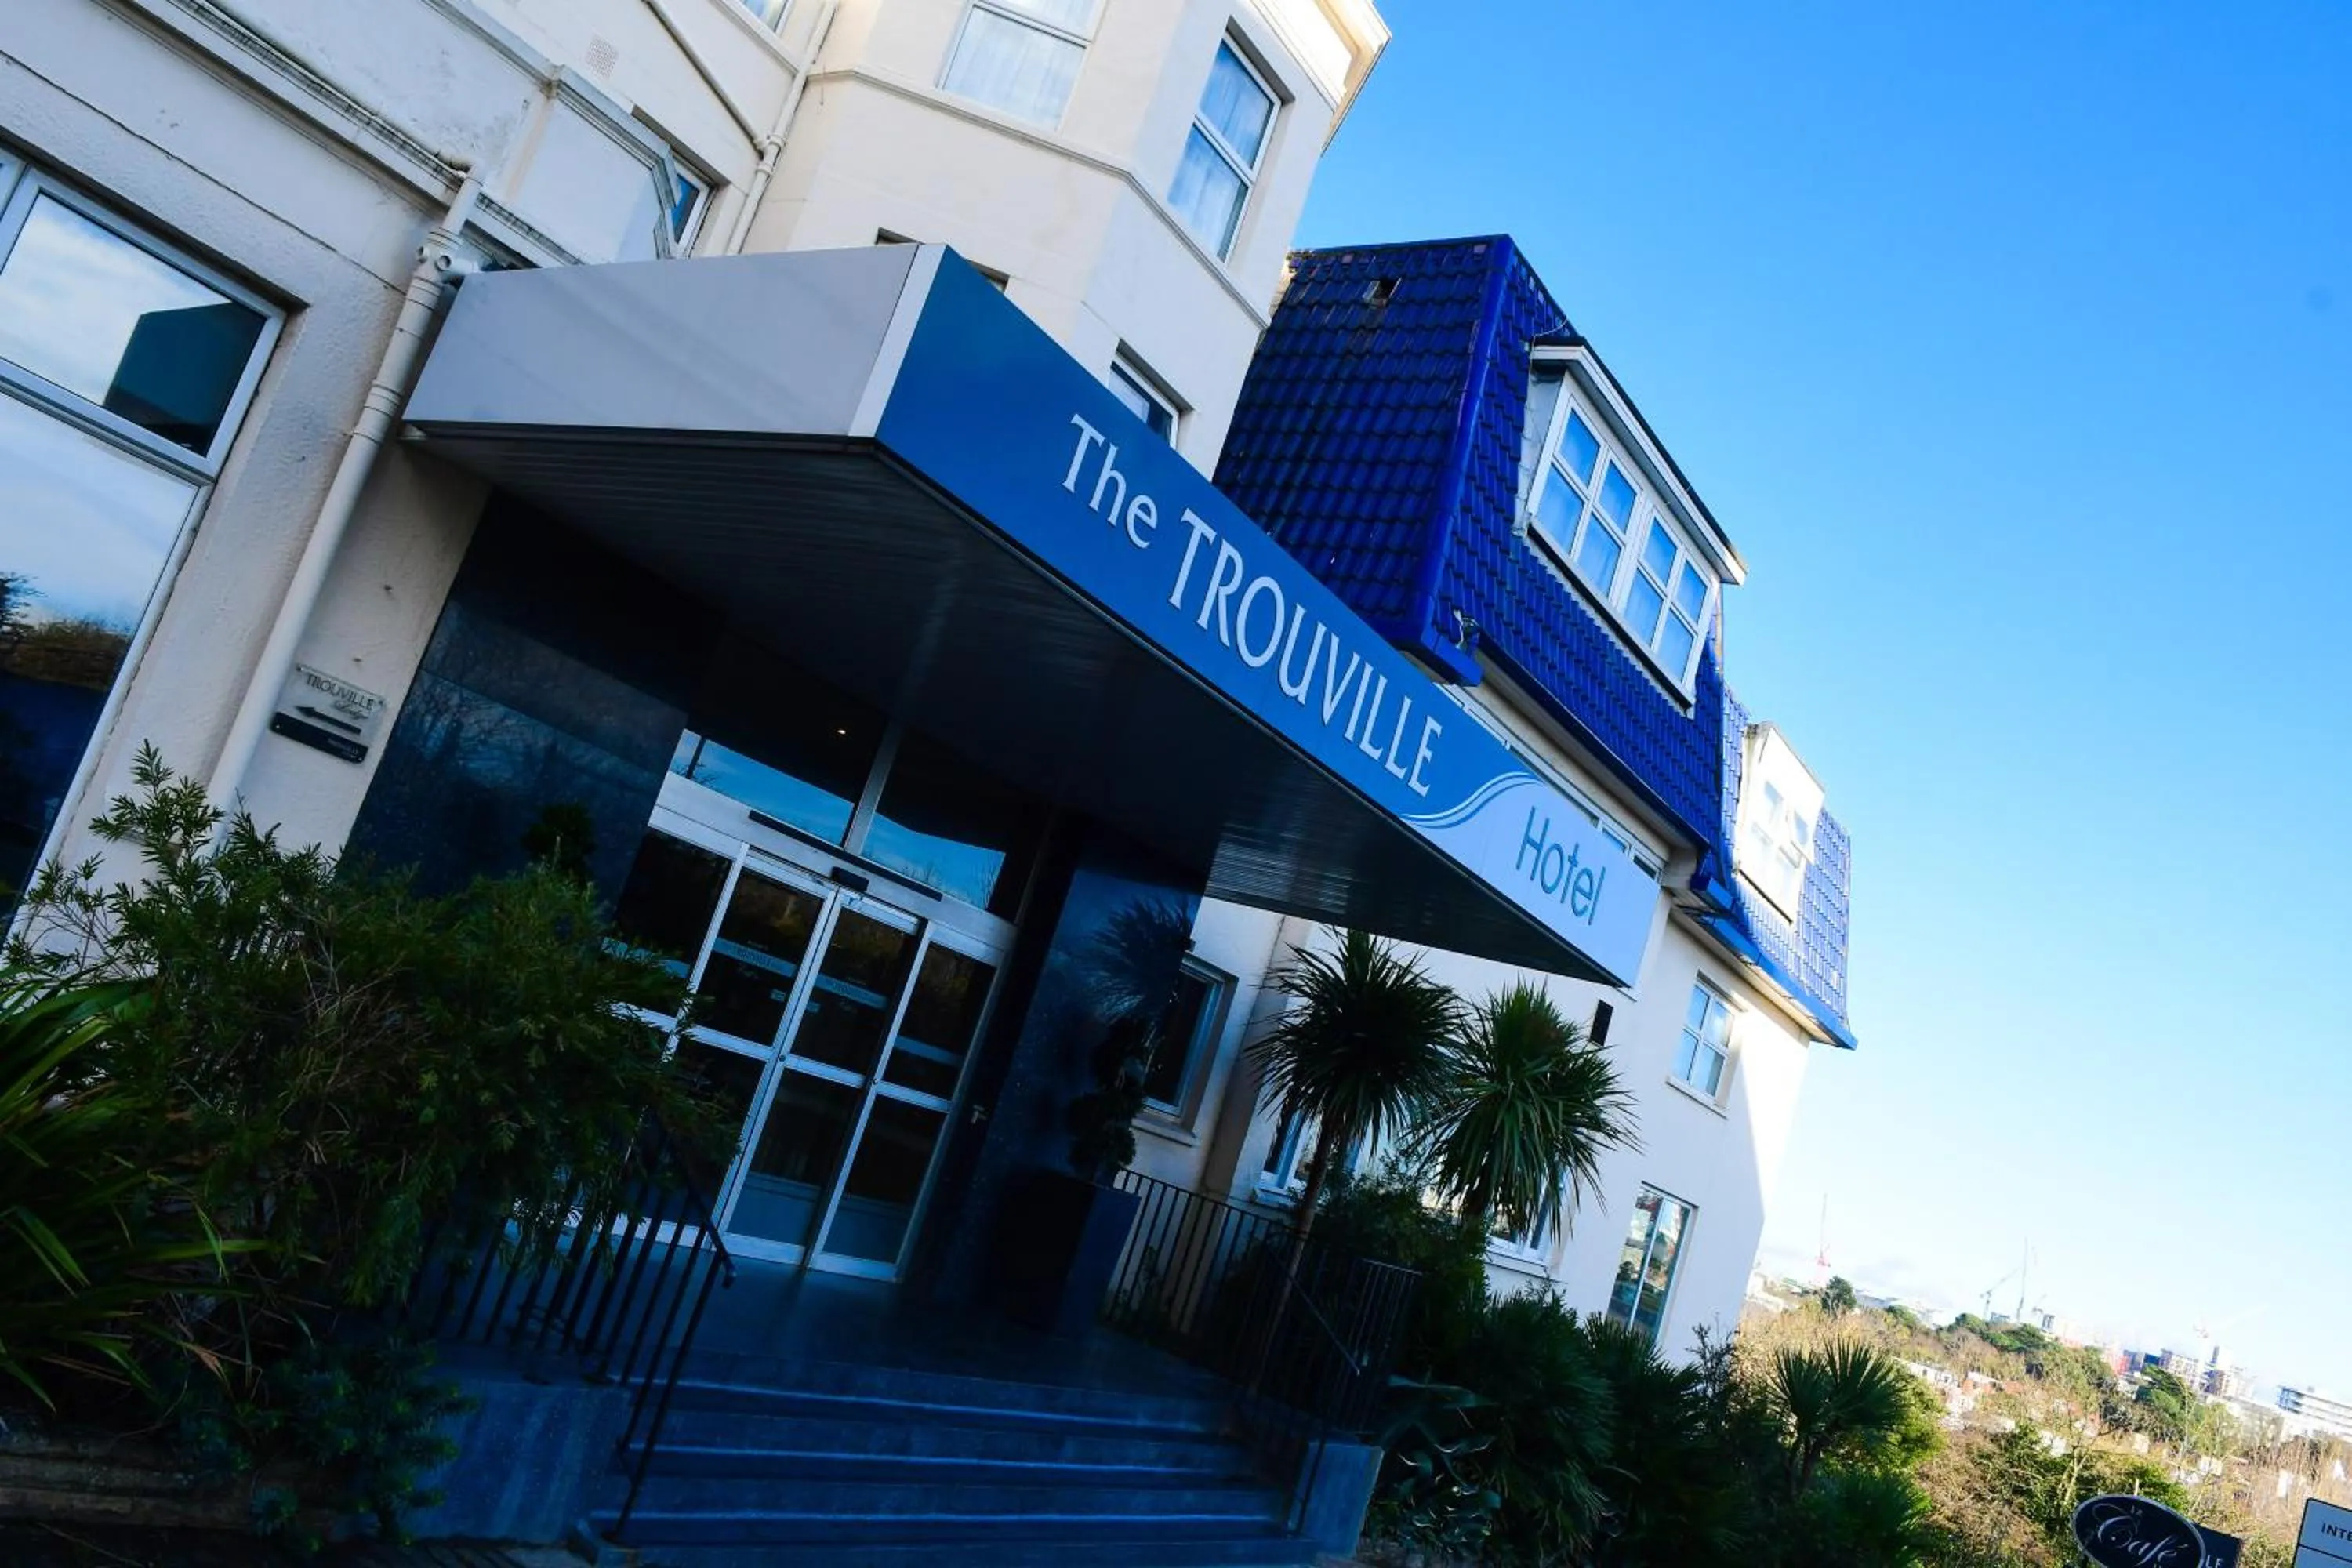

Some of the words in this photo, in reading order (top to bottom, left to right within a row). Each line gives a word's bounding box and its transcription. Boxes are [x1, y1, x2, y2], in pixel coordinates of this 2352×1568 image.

[306, 673, 375, 711] TROUVILLE
[1061, 414, 1159, 549] The
[1167, 506, 1443, 797] TROUVILLE
[1515, 805, 1607, 926] Hotel
